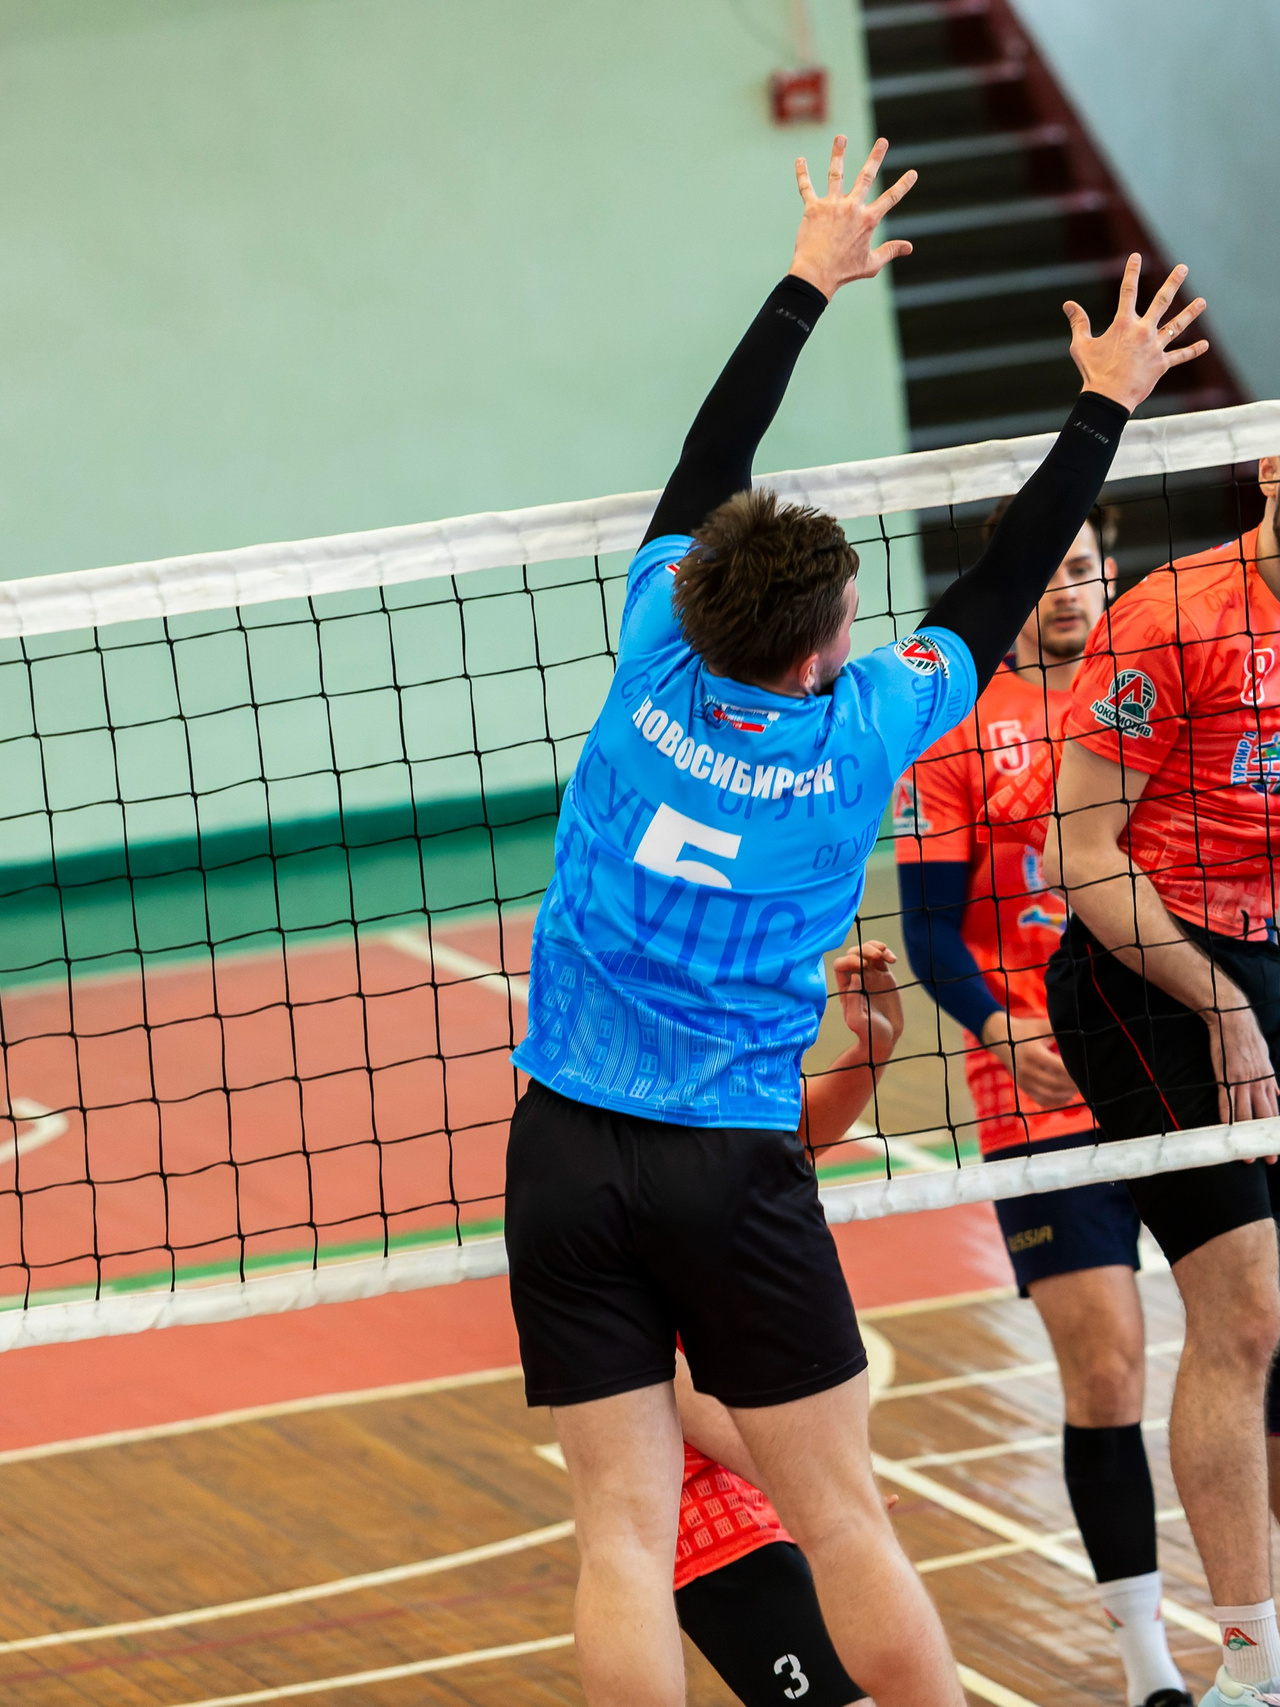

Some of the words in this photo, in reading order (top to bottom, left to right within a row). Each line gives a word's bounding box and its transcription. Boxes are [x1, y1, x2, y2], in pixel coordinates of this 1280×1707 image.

[1240, 647, 1275, 705] 8
[632, 694, 835, 800] НОВОСИБИРСК
[988, 720, 1030, 776] 5
[773, 1653, 810, 1700] 3
